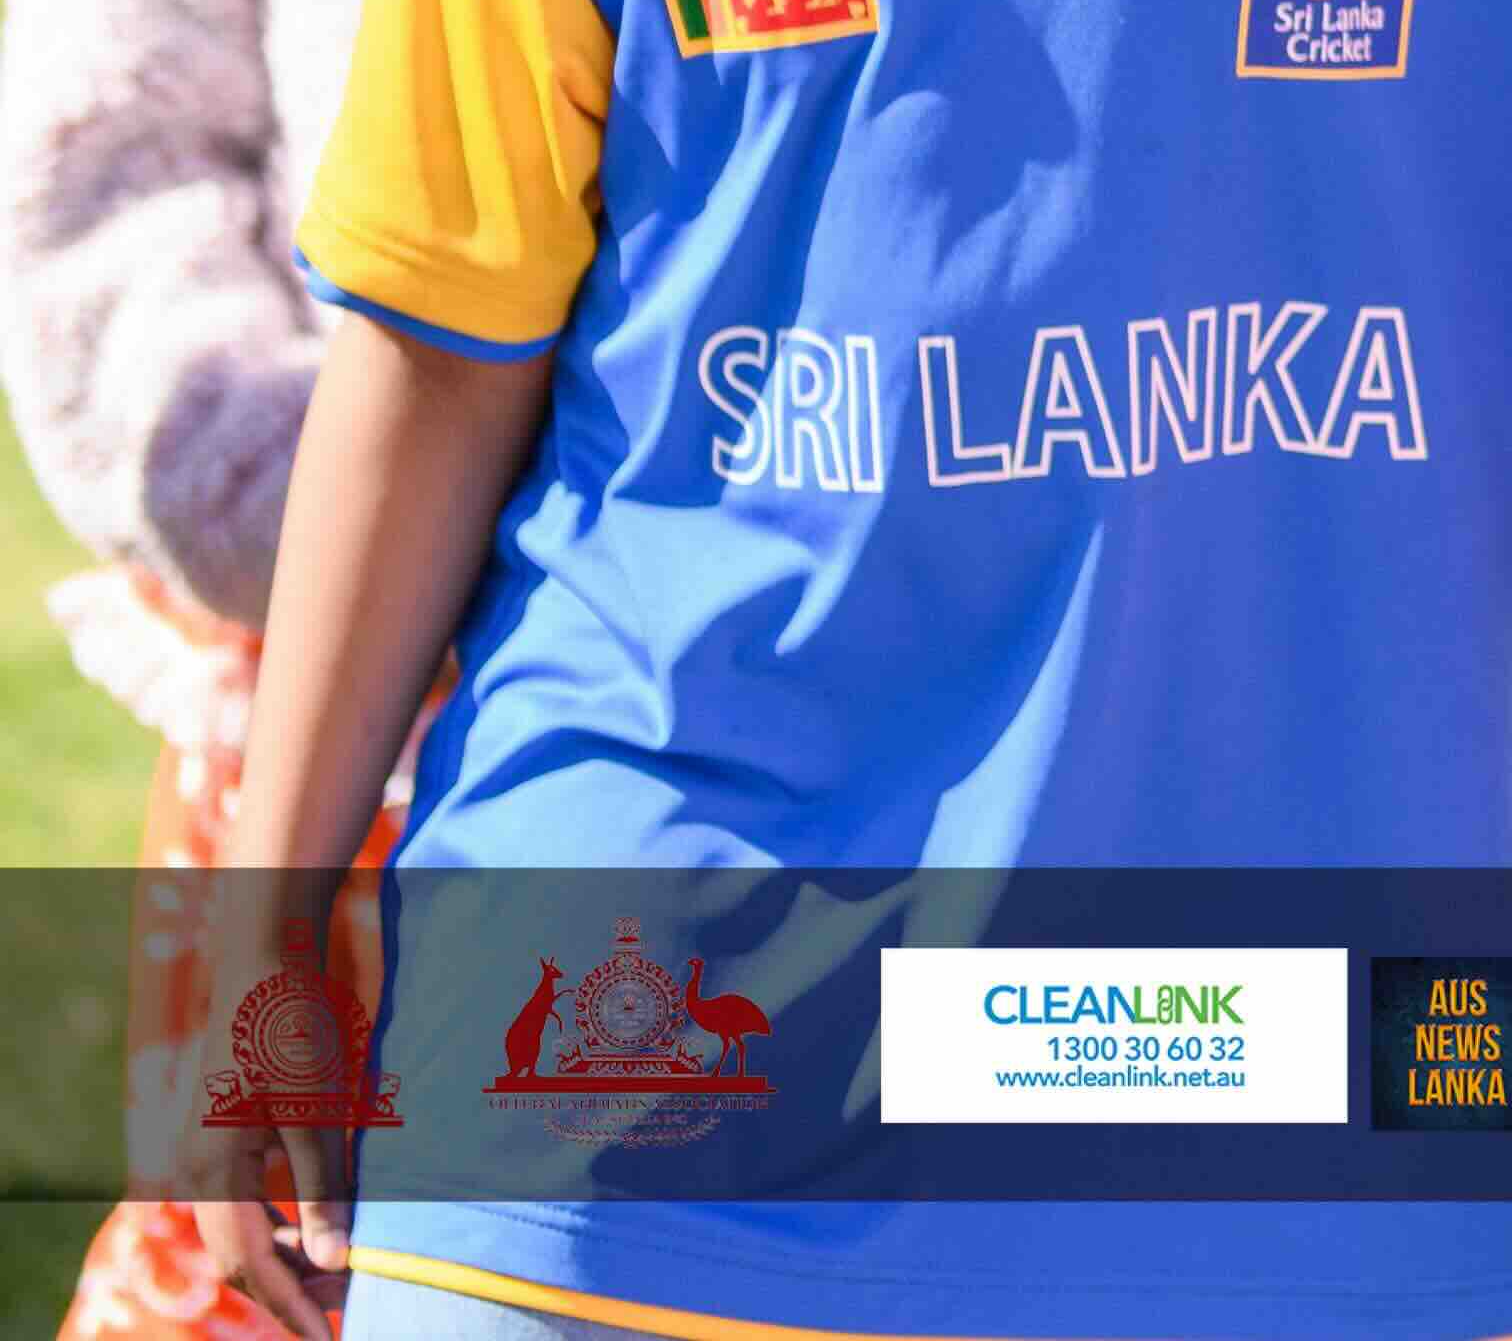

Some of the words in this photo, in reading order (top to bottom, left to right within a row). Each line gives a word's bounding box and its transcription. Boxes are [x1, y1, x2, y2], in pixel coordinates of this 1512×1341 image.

[1275, 1, 1312, 34] Sri
[1321, 1, 1385, 34] Lanka
[1286, 33, 1372, 63] Cricket
[698, 326, 884, 493] SRI
[918, 301, 1428, 488] LANKA
